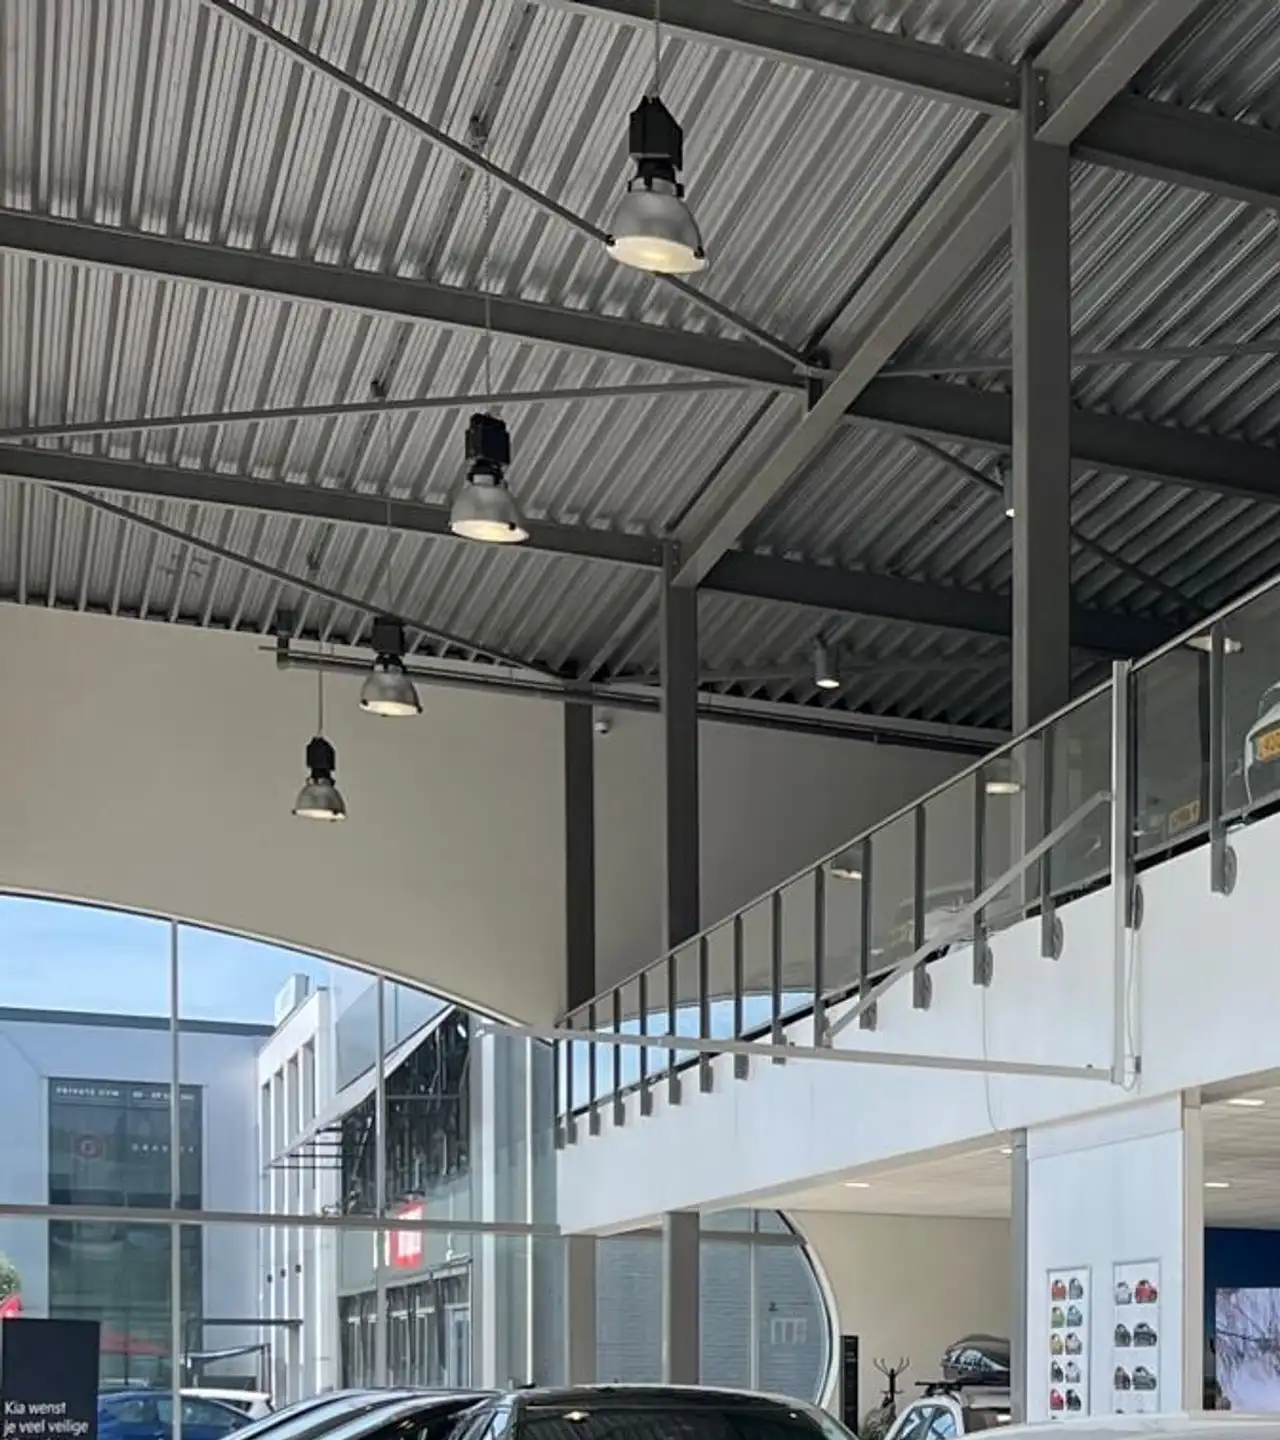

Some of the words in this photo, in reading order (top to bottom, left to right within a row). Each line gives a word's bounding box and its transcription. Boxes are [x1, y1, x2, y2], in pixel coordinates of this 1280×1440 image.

[4, 1401, 26, 1415] Kia
[28, 1401, 66, 1415] wenst
[3, 1420, 16, 1438] je
[19, 1419, 46, 1434] veel
[48, 1419, 90, 1437] veilige
